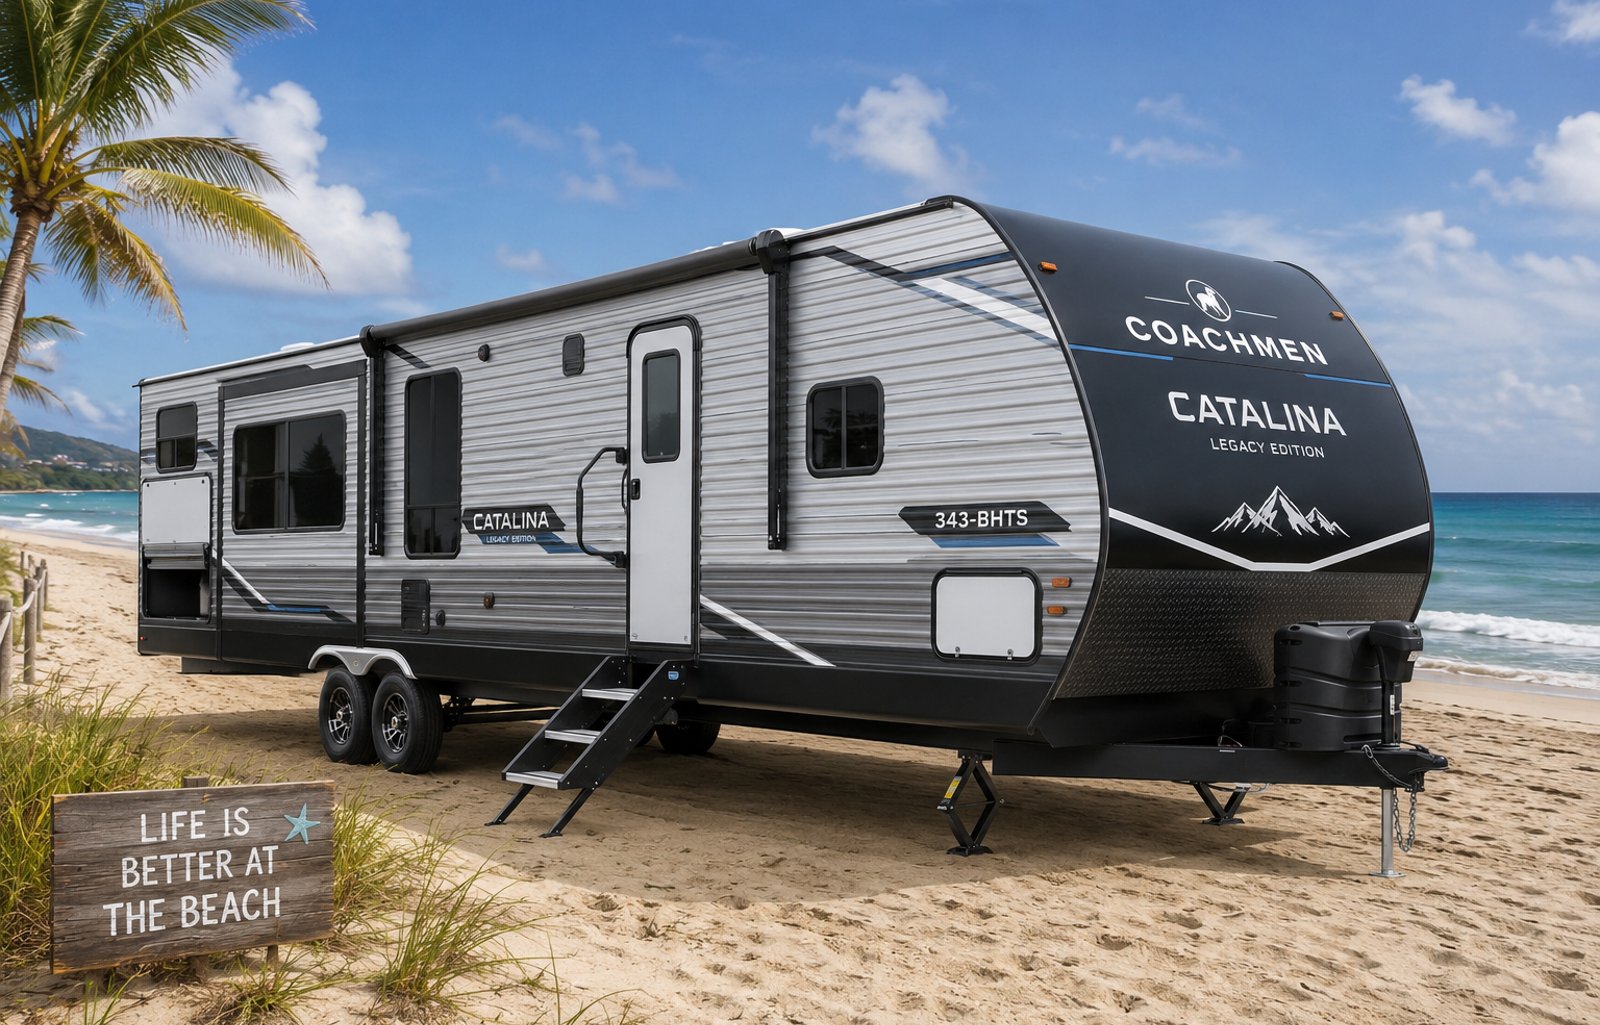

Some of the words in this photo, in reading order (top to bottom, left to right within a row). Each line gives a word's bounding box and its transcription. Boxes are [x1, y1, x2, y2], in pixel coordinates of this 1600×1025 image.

[1125, 316, 1328, 365] COACHMEN
[1168, 391, 1347, 436] CATALINA
[1210, 437, 1265, 454] LEGACY
[1270, 442, 1325, 458] EDITION
[473, 511, 549, 530] CATALINA
[935, 509, 1028, 529] 343-BHTS
[140, 810, 206, 842] LIFE
[223, 806, 250, 837] IS
[121, 849, 233, 888] BETTER
[245, 845, 279, 876] AT
[102, 898, 166, 936] THE
[180, 886, 281, 928] BEACH
